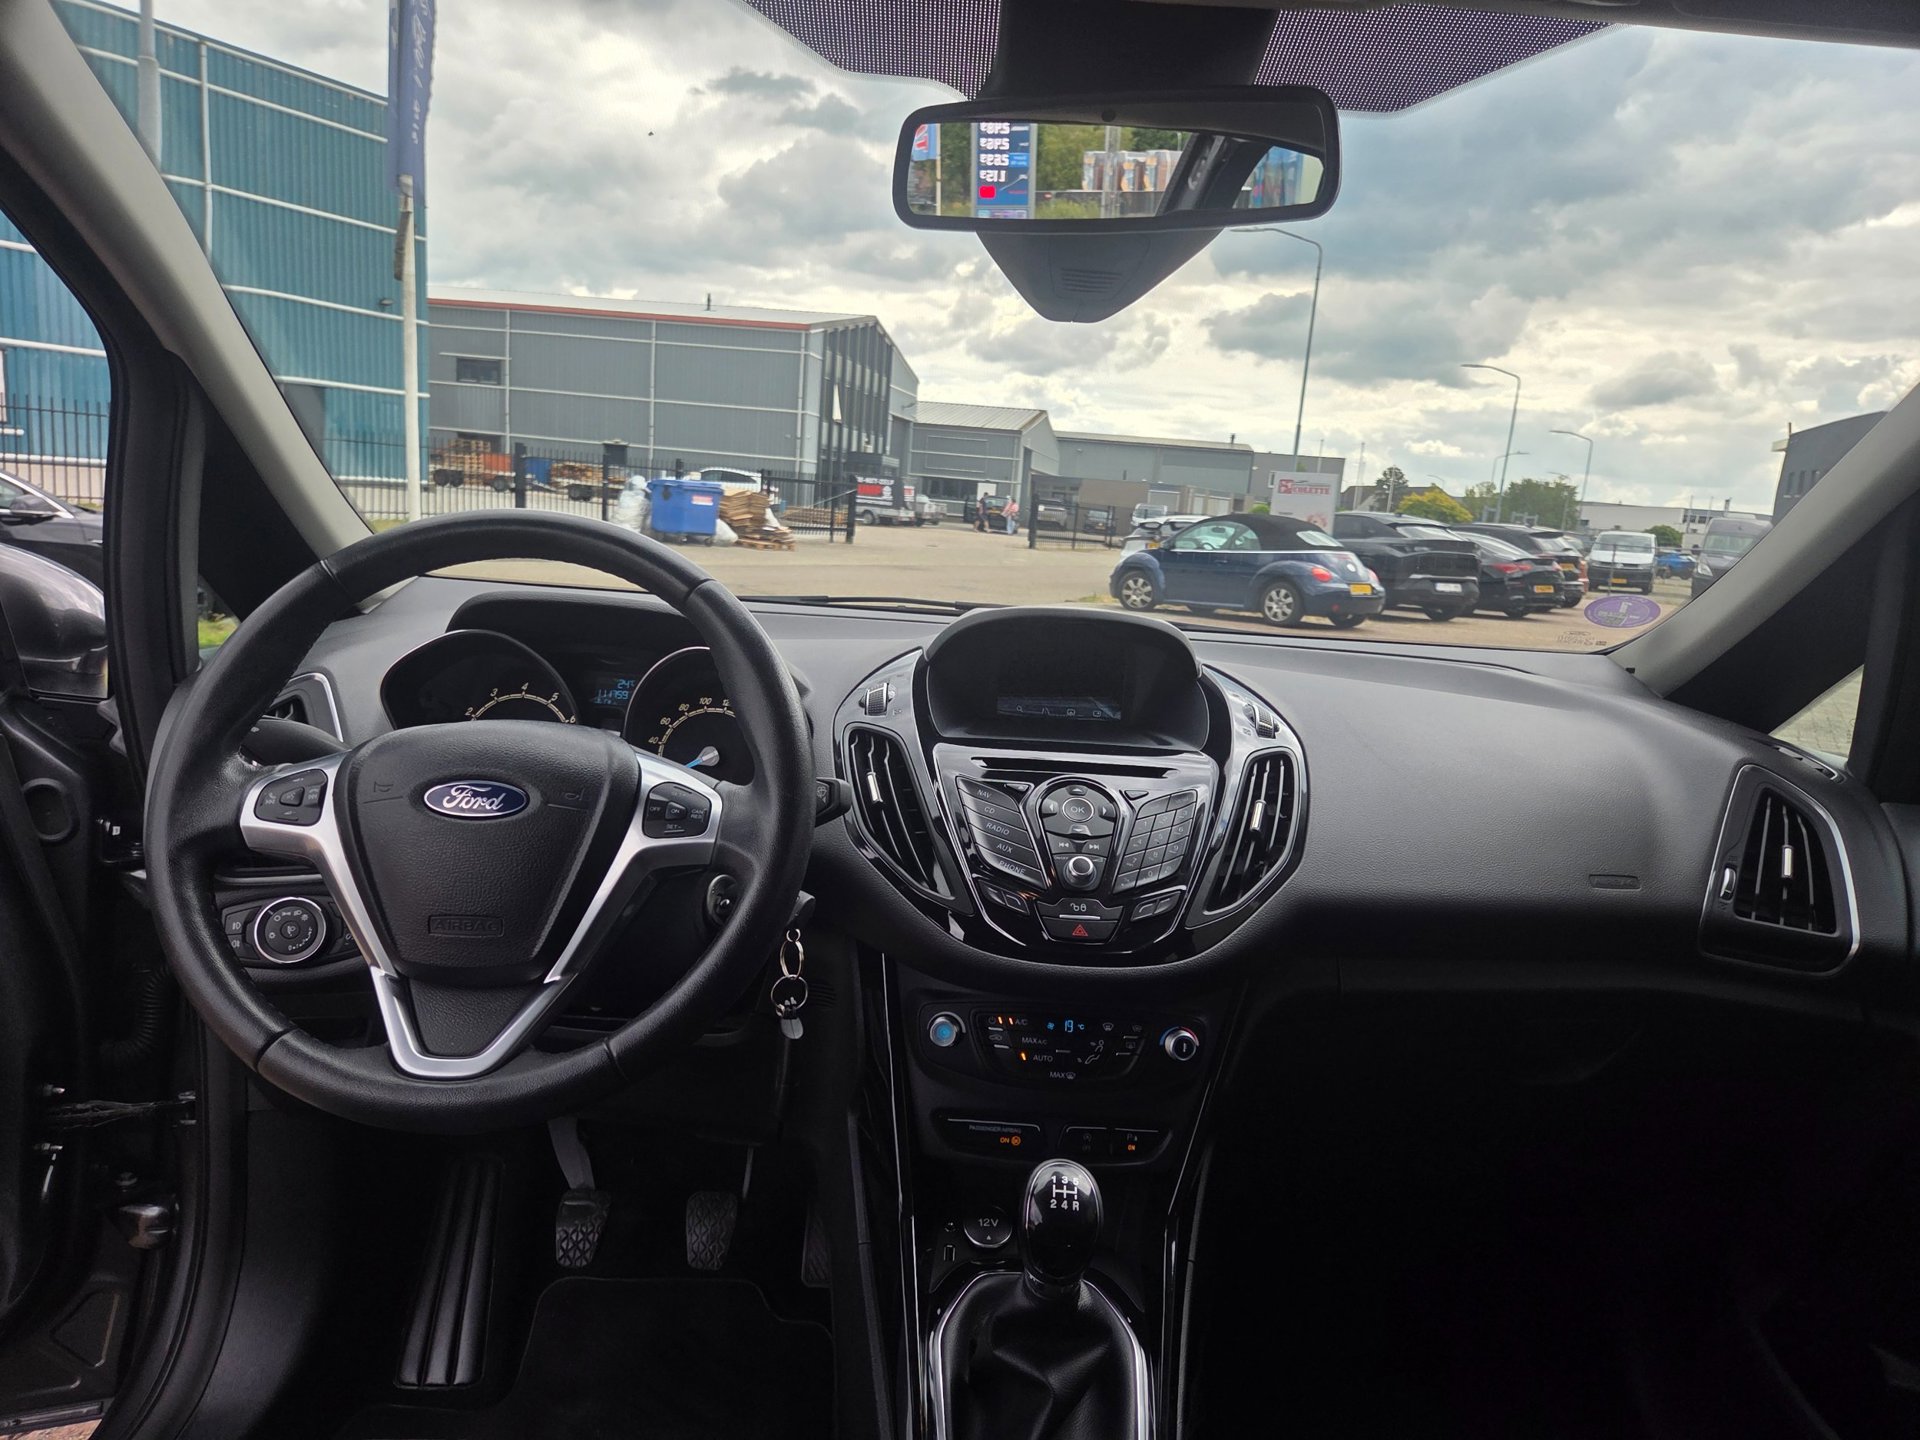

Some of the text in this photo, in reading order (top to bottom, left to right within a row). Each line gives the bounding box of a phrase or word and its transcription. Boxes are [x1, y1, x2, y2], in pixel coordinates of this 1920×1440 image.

[521, 682, 529, 690] 4
[490, 688, 498, 697] 3
[550, 692, 559, 701] 5
[699, 697, 712, 705] 100
[465, 707, 474, 716] 2
[678, 703, 690, 711] 80
[569, 715, 576, 723] 6
[660, 717, 671, 725] 60
[648, 736, 659, 744] 40
[442, 784, 507, 810] Ford
[977, 789, 993, 798] NAV
[984, 806, 996, 814] CD
[1070, 805, 1086, 813] OK
[985, 822, 1010, 836] RADIO
[996, 843, 1013, 854] AUX
[998, 860, 1026, 875] PHONE
[1021, 1036, 1037, 1044] MAX
[1032, 1054, 1054, 1062] AUTO
[1051, 1175, 1080, 1186] 1 3 5
[1050, 1200, 1080, 1211] 2 4 R
[978, 1218, 999, 1227] 12V
